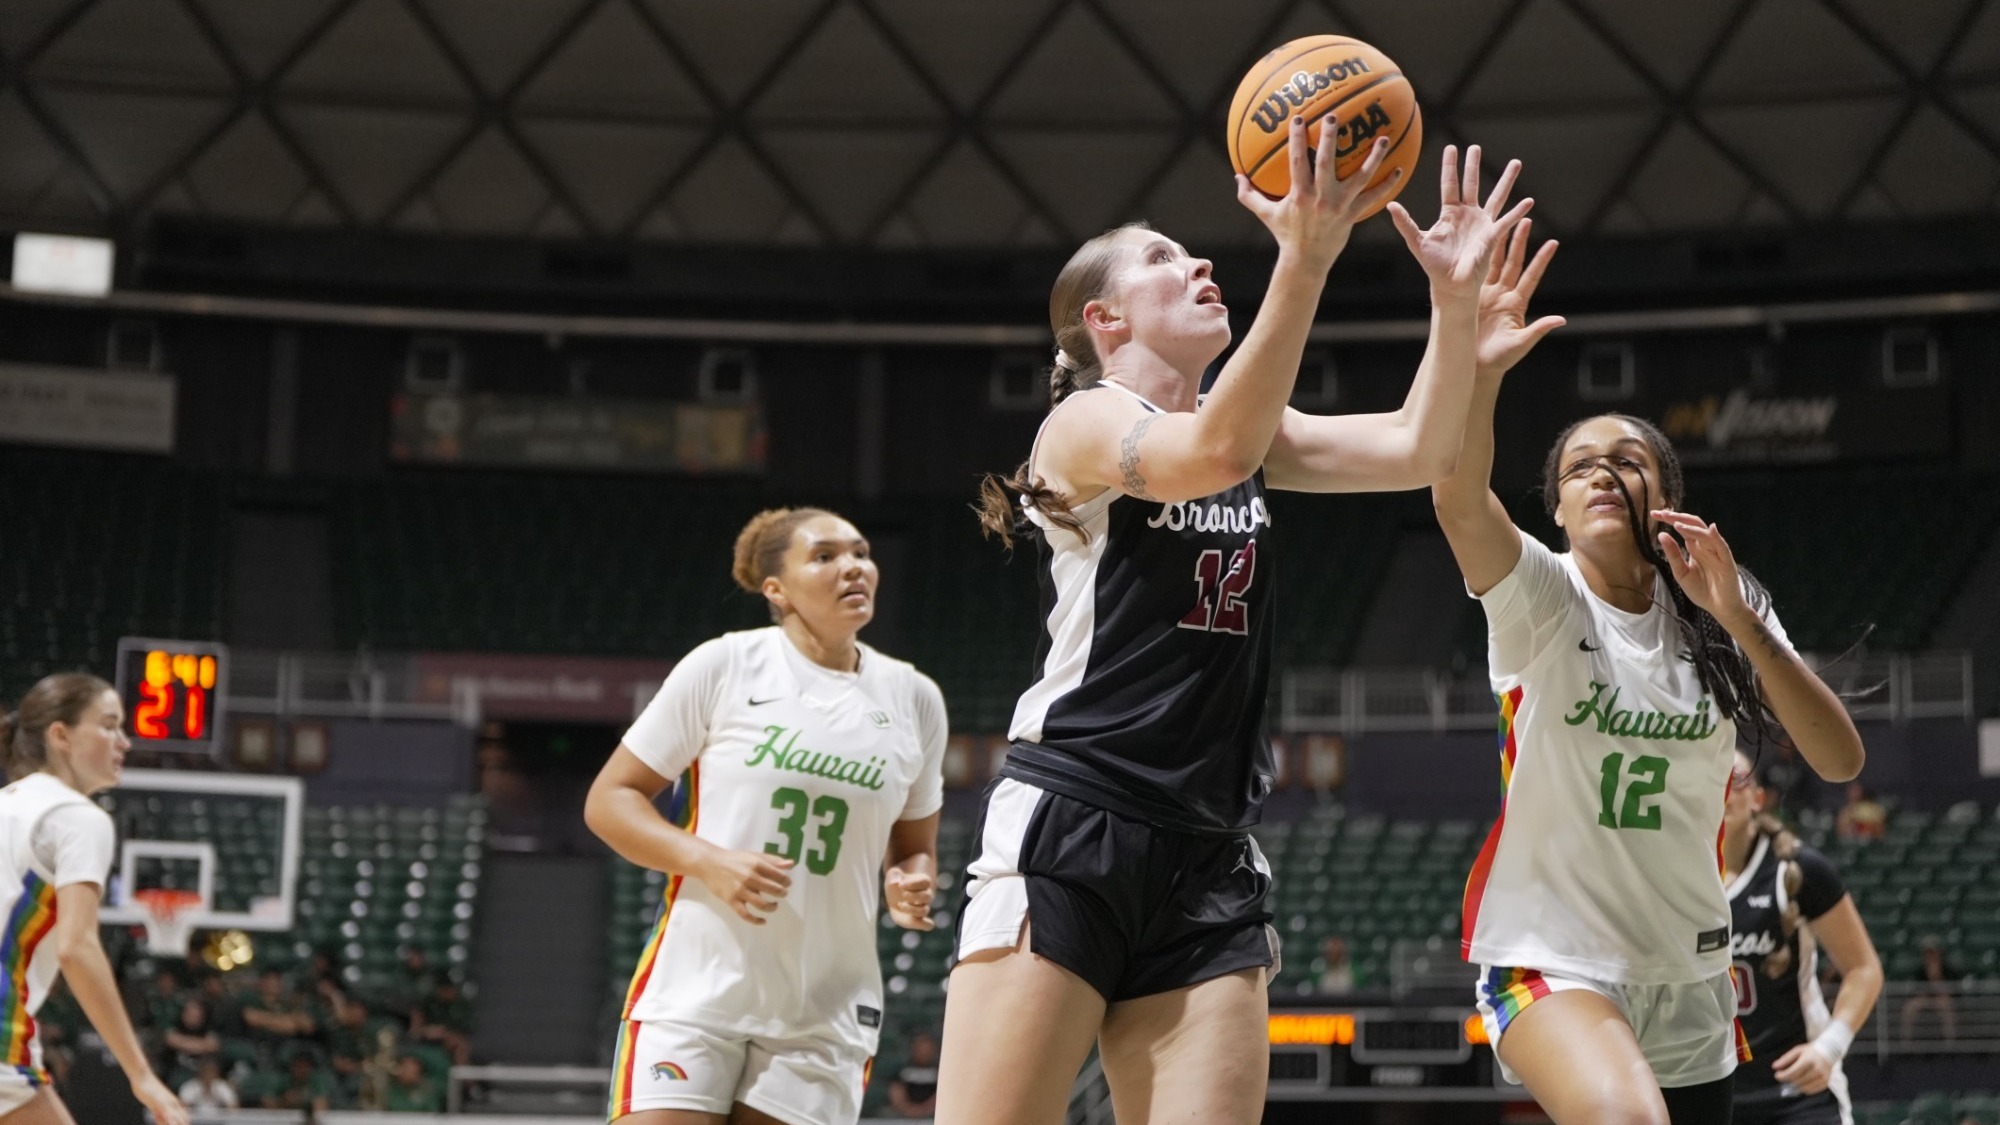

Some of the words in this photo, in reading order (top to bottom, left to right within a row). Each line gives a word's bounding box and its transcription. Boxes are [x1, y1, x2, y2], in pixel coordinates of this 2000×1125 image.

[1250, 56, 1371, 134] Wilson
[1177, 538, 1257, 636] 12
[134, 680, 206, 740] 21
[1564, 680, 1717, 742] Hawaii
[744, 724, 887, 792] Hawaii
[1598, 751, 1671, 832] 12
[763, 786, 849, 877] 33
